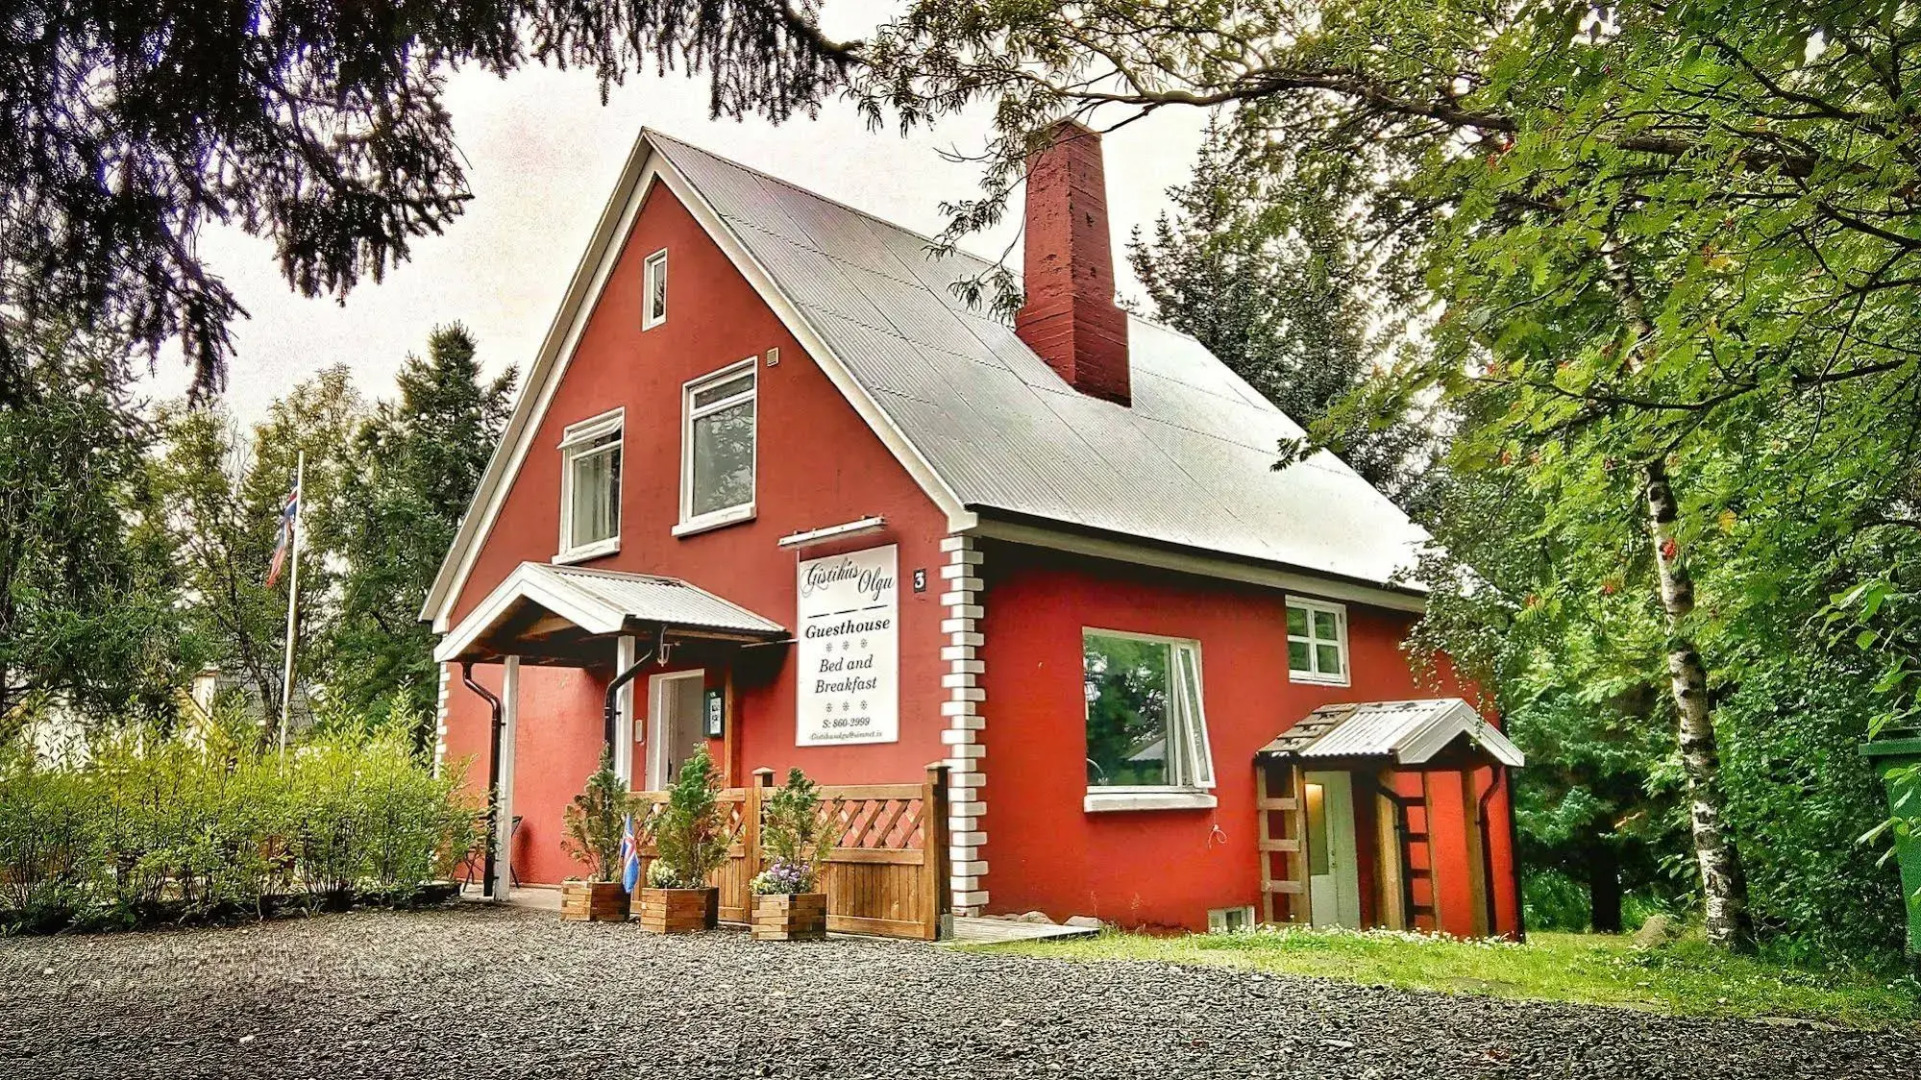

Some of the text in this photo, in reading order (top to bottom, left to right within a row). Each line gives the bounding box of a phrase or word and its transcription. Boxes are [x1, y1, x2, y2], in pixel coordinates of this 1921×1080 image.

[858, 566, 894, 601] Olgu
[914, 571, 925, 589] 3
[805, 618, 890, 639] Guesthouse
[819, 654, 874, 673] Bed and
[815, 676, 877, 694] Breakfast
[832, 717, 871, 729] 860-2999
